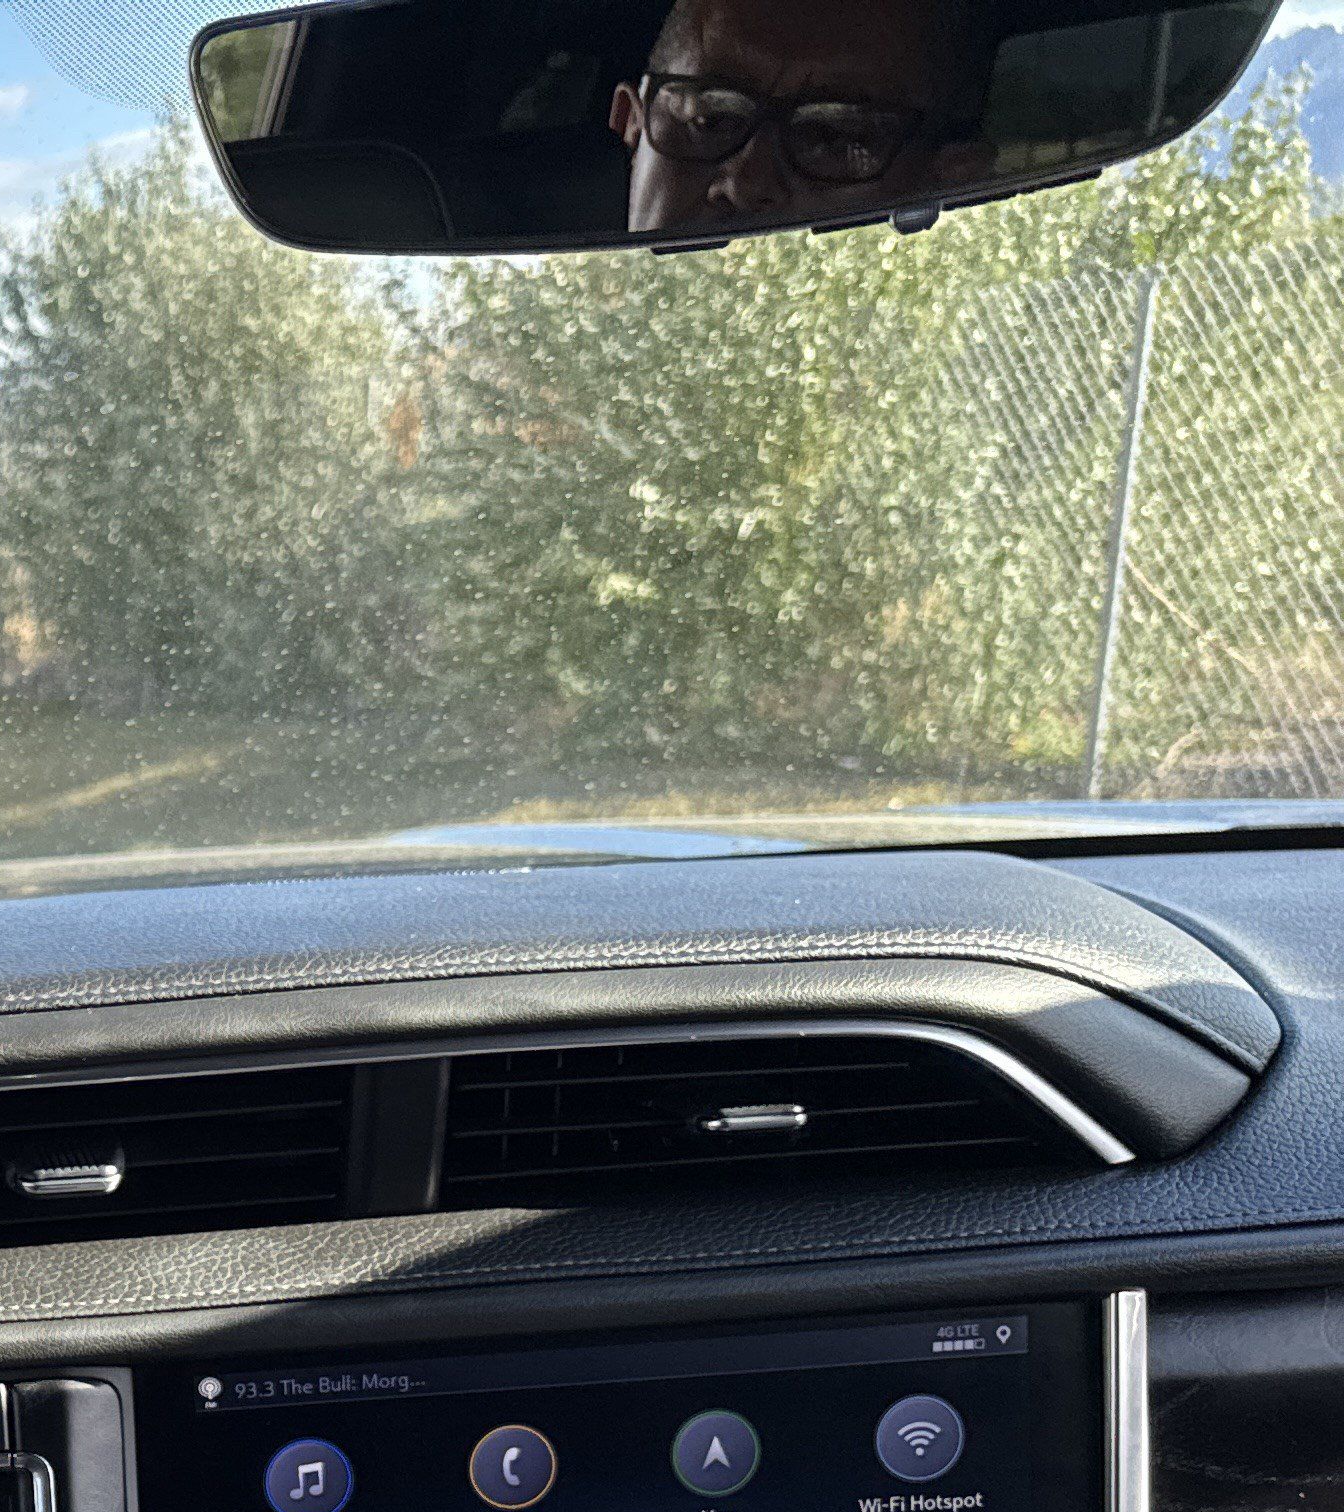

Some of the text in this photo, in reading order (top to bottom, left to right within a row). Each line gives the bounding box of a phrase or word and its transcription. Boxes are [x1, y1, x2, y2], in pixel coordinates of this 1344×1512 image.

[936, 1324, 979, 1338] 4G LTE
[234, 1381, 276, 1400] 93.3
[279, 1378, 314, 1396] The
[318, 1375, 358, 1393] Bull:
